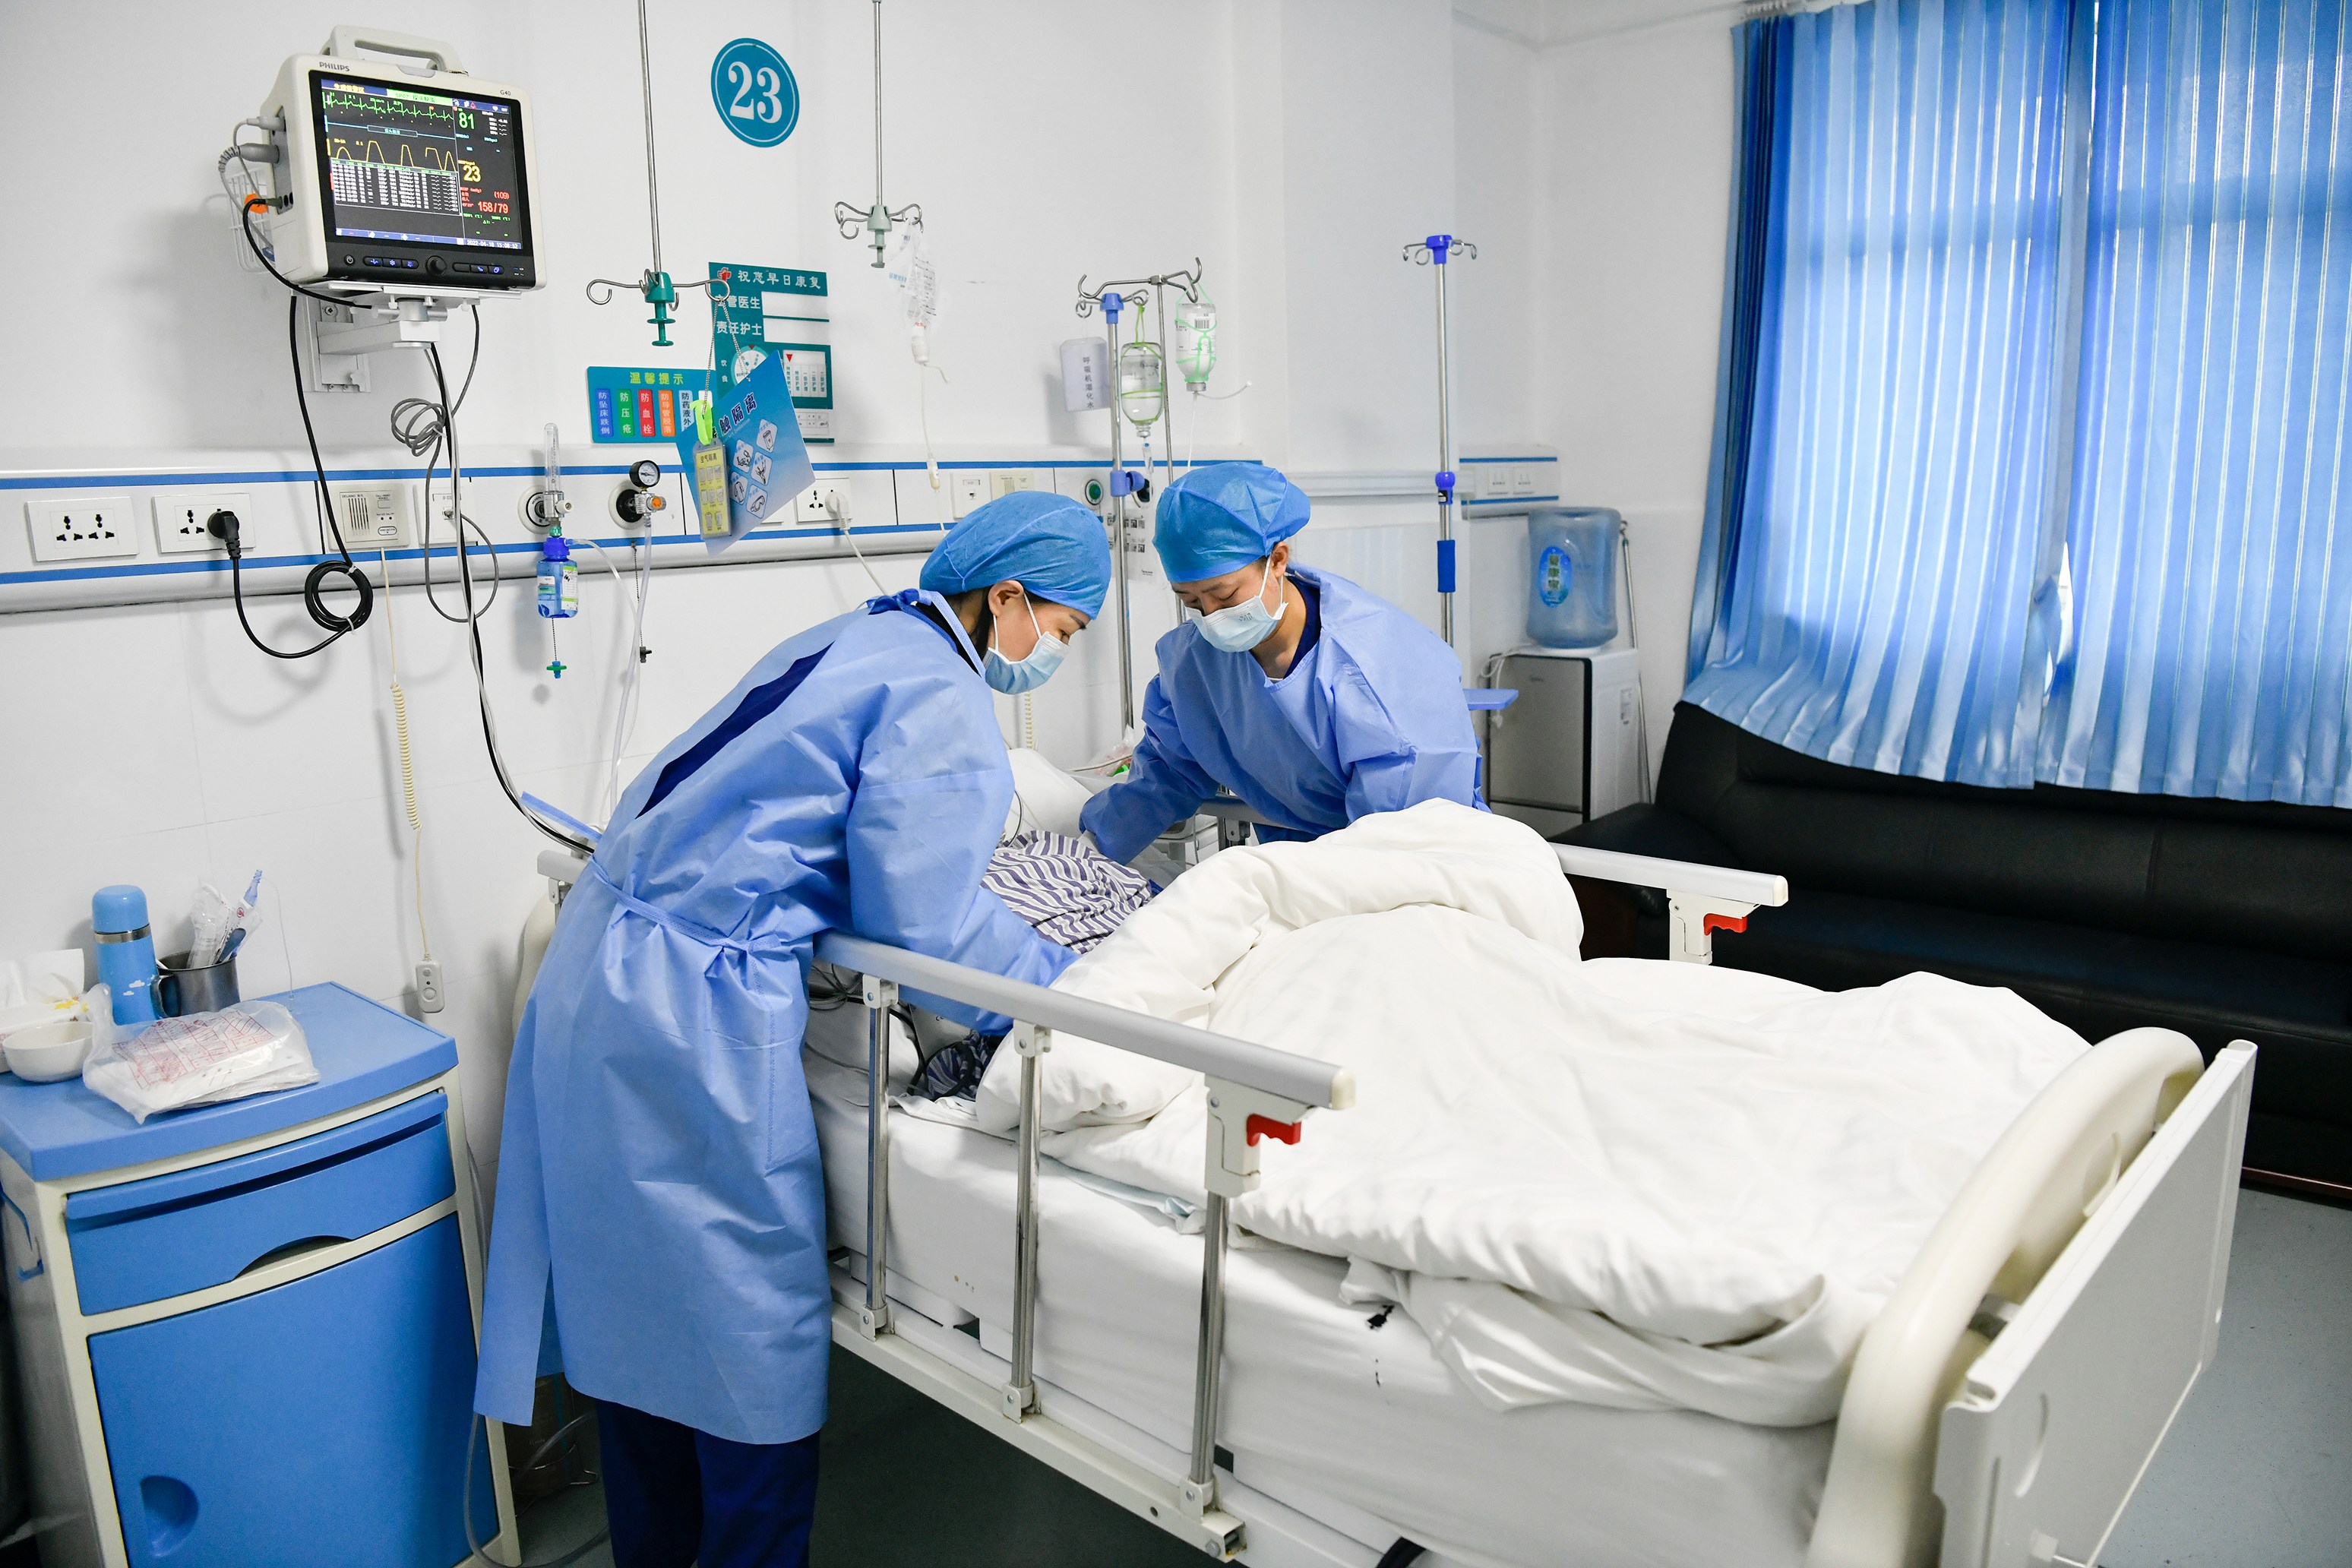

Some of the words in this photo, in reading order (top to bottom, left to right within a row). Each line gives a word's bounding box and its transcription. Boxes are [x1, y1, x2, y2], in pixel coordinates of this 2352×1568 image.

[318, 62, 350, 72] PHILIPS
[728, 61, 782, 124] 23
[458, 112, 475, 130] 81
[463, 164, 482, 182] 23
[494, 191, 510, 200] (109)
[478, 201, 509, 214] 158/79
[738, 270, 821, 290] 祝您早日康复
[716, 320, 762, 336] 责任护士
[629, 371, 684, 385] 温馨提示
[598, 391, 610, 435] 防坠床跌倒
[619, 392, 632, 434] 防压疮
[640, 393, 653, 435] 防血栓
[661, 393, 672, 434] 防导管脱落
[681, 392, 691, 430] 防药液外
[712, 392, 757, 438] 触隔离
